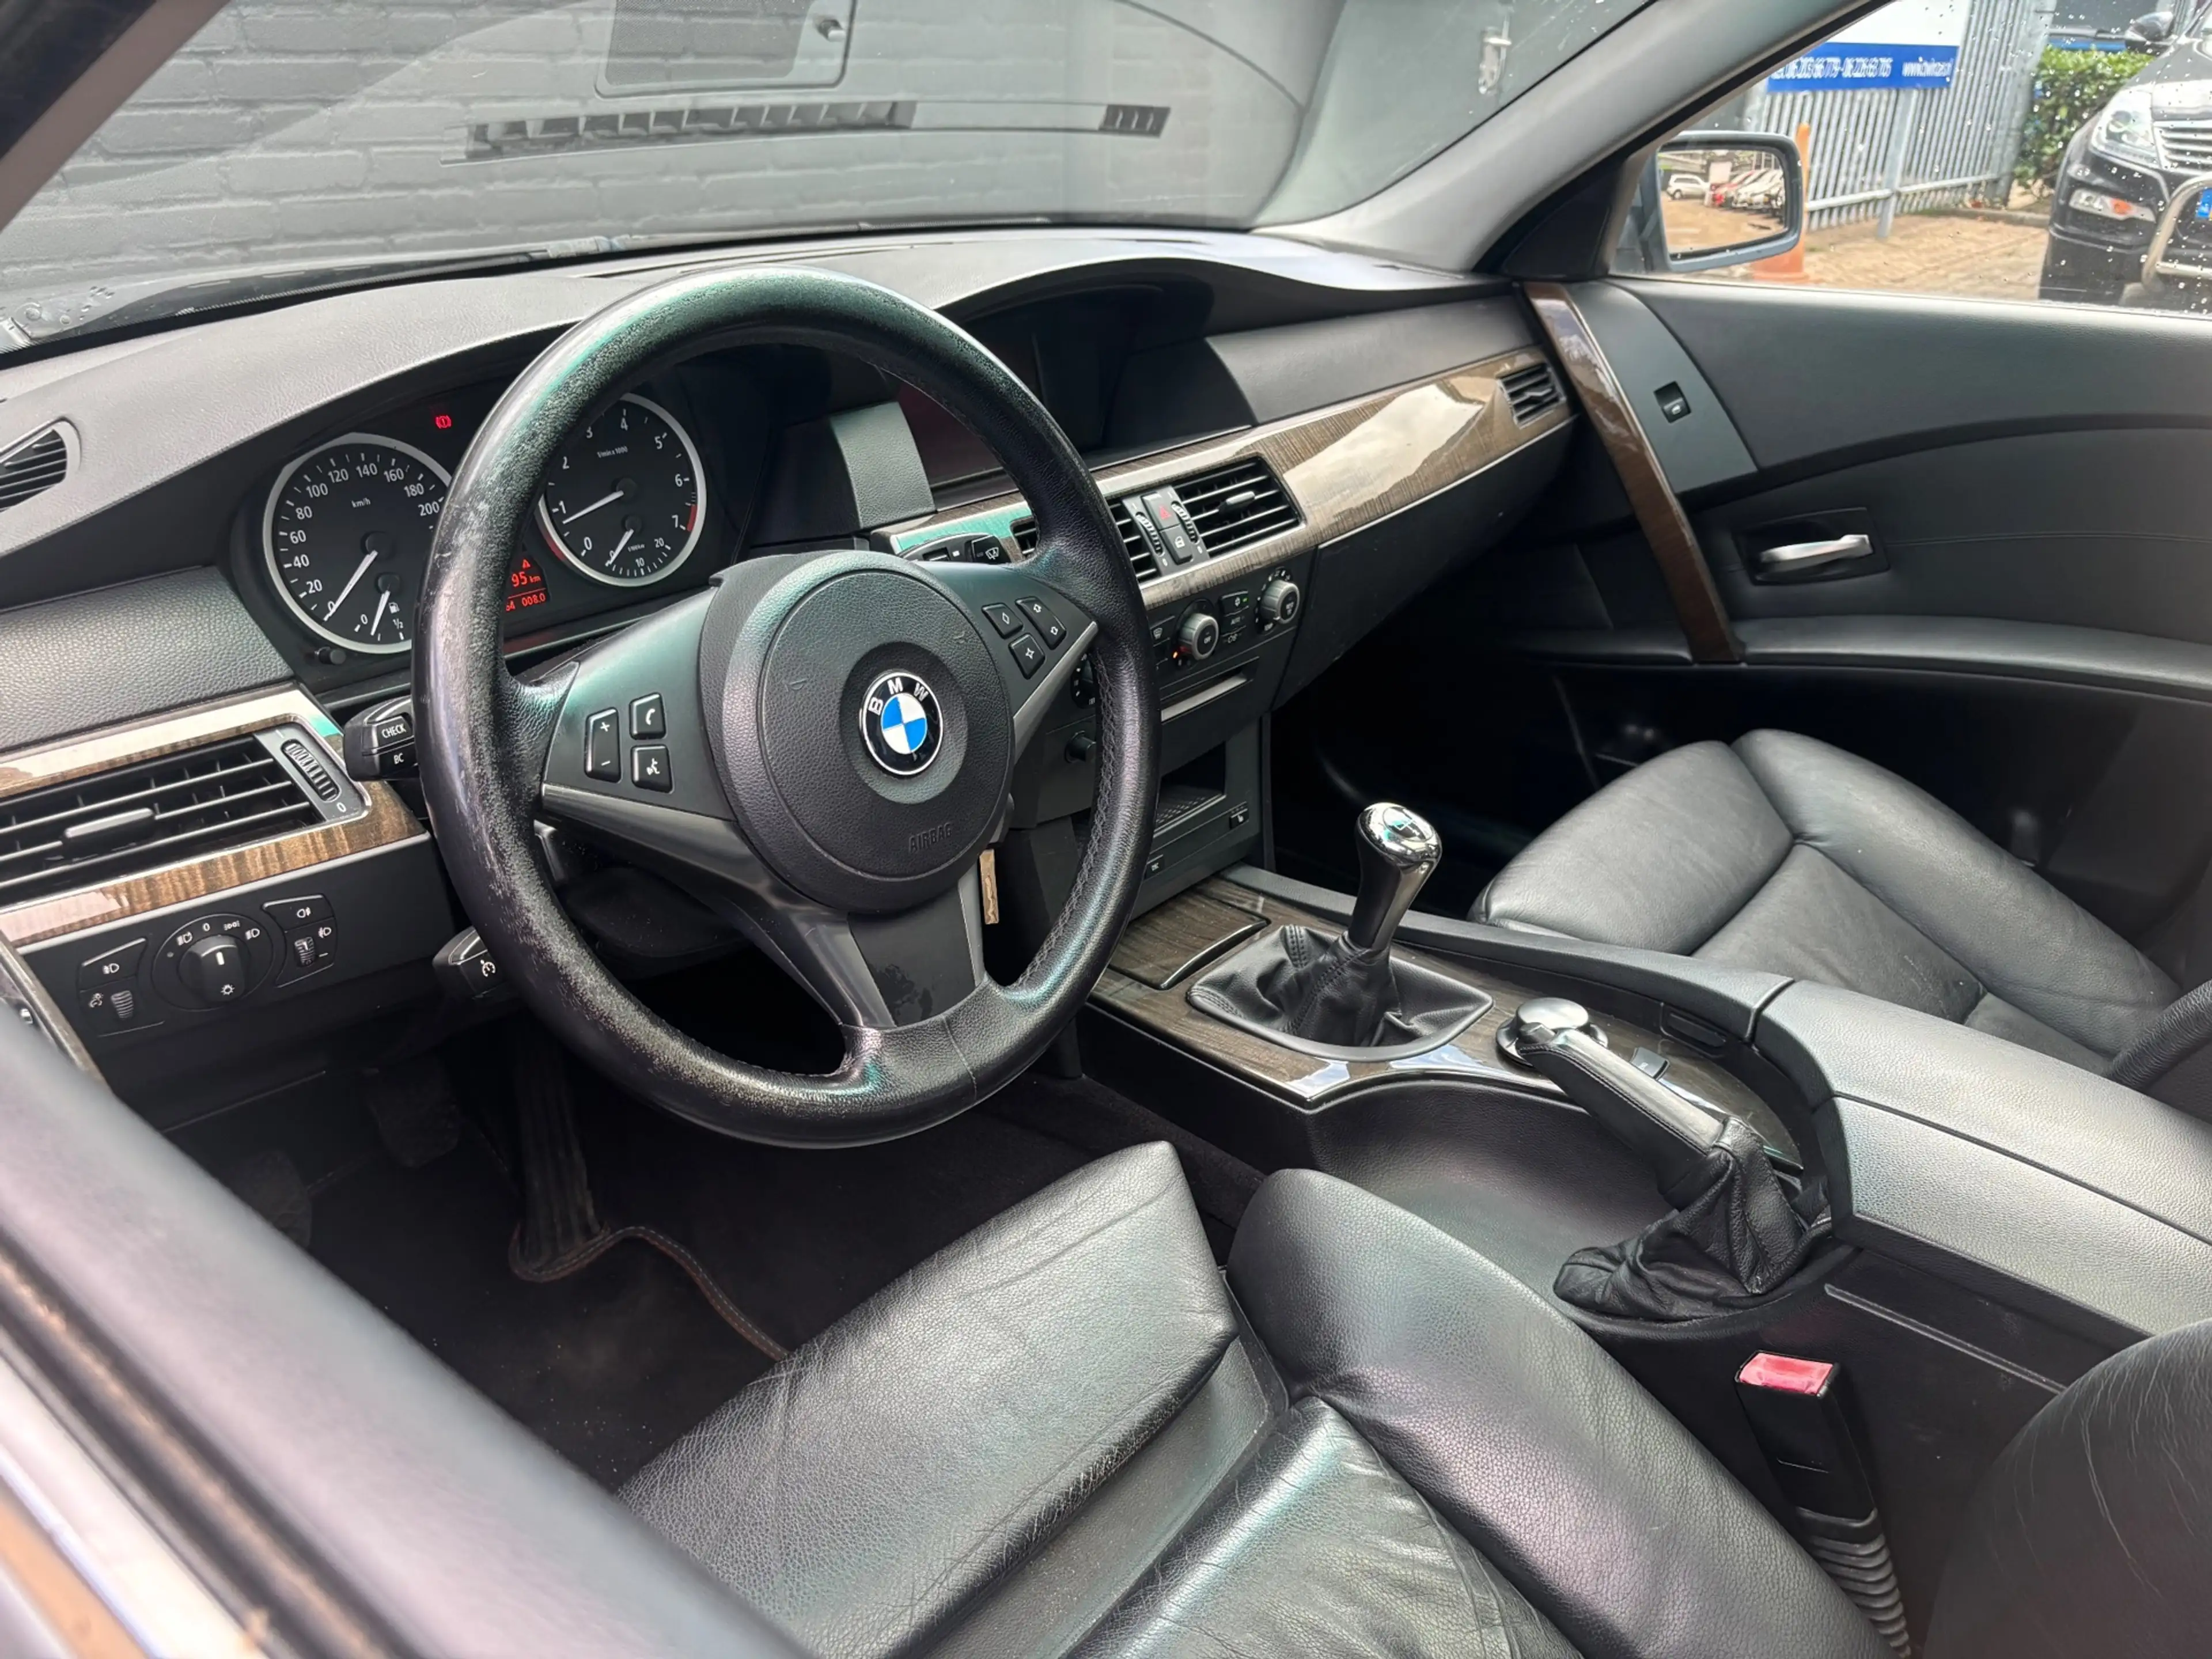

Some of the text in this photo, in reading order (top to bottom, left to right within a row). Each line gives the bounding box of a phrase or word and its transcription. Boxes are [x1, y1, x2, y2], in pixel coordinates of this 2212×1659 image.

[620, 417, 628, 431] 4
[586, 426, 593, 438] 3
[654, 436, 663, 449] 5
[562, 456, 570, 469] 2
[328, 468, 350, 484] 120
[357, 463, 378, 478] 140
[384, 468, 404, 482] 160
[675, 474, 683, 487] 6
[306, 483, 328, 499] 100
[404, 483, 425, 497] 180
[351, 497, 371, 508] km/h
[418, 501, 440, 517] 200
[559, 500, 566, 514] 1
[296, 506, 312, 520] 80
[672, 514, 679, 528] 7
[290, 530, 306, 544] 60
[584, 536, 592, 550] 0
[654, 537, 665, 548] 20
[293, 554, 309, 569] 40
[635, 557, 645, 567] 10
[512, 571, 528, 587] 95
[306, 579, 323, 594] 20
[521, 593, 546, 607] 008.0
[360, 613, 368, 624] 0
[868, 677, 929, 716] BMW
[381, 723, 407, 738] CHECK
[393, 752, 404, 764] BC
[908, 822, 953, 853] AIRBAG
